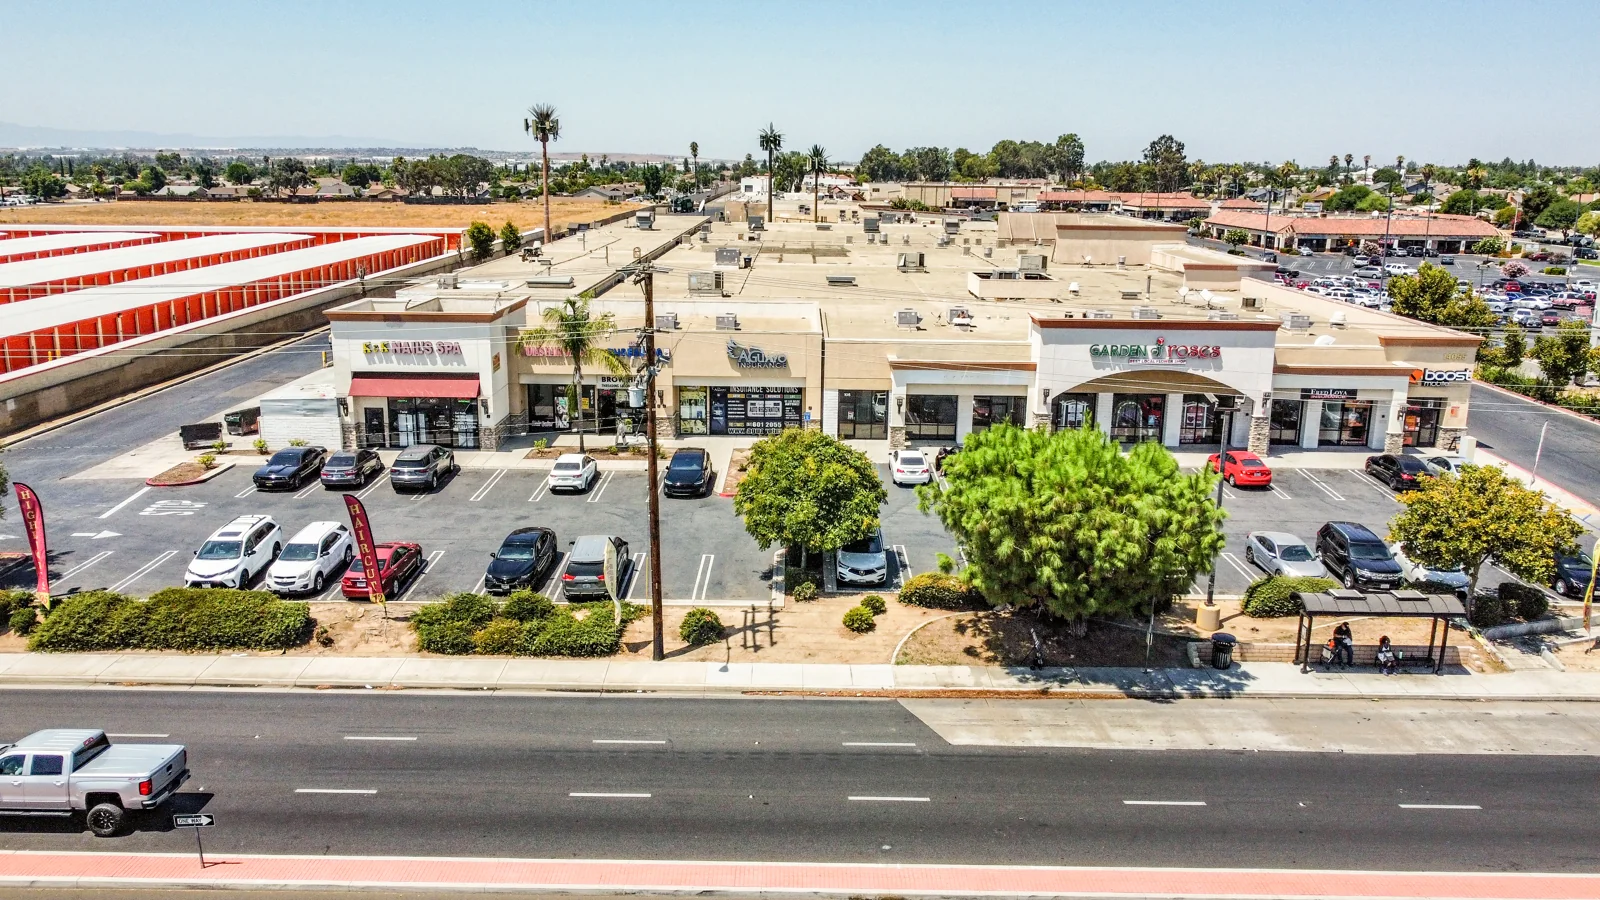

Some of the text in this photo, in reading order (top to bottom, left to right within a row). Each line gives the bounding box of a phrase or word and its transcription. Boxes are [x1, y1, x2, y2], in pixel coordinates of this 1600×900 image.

[392, 341, 434, 354] NAIL'S
[436, 342, 462, 354] SPA
[1090, 344, 1149, 357] GARDEN
[738, 350, 787, 362] AGUAYO
[1424, 368, 1471, 381] boost
[349, 503, 378, 591] HAIRCUT
